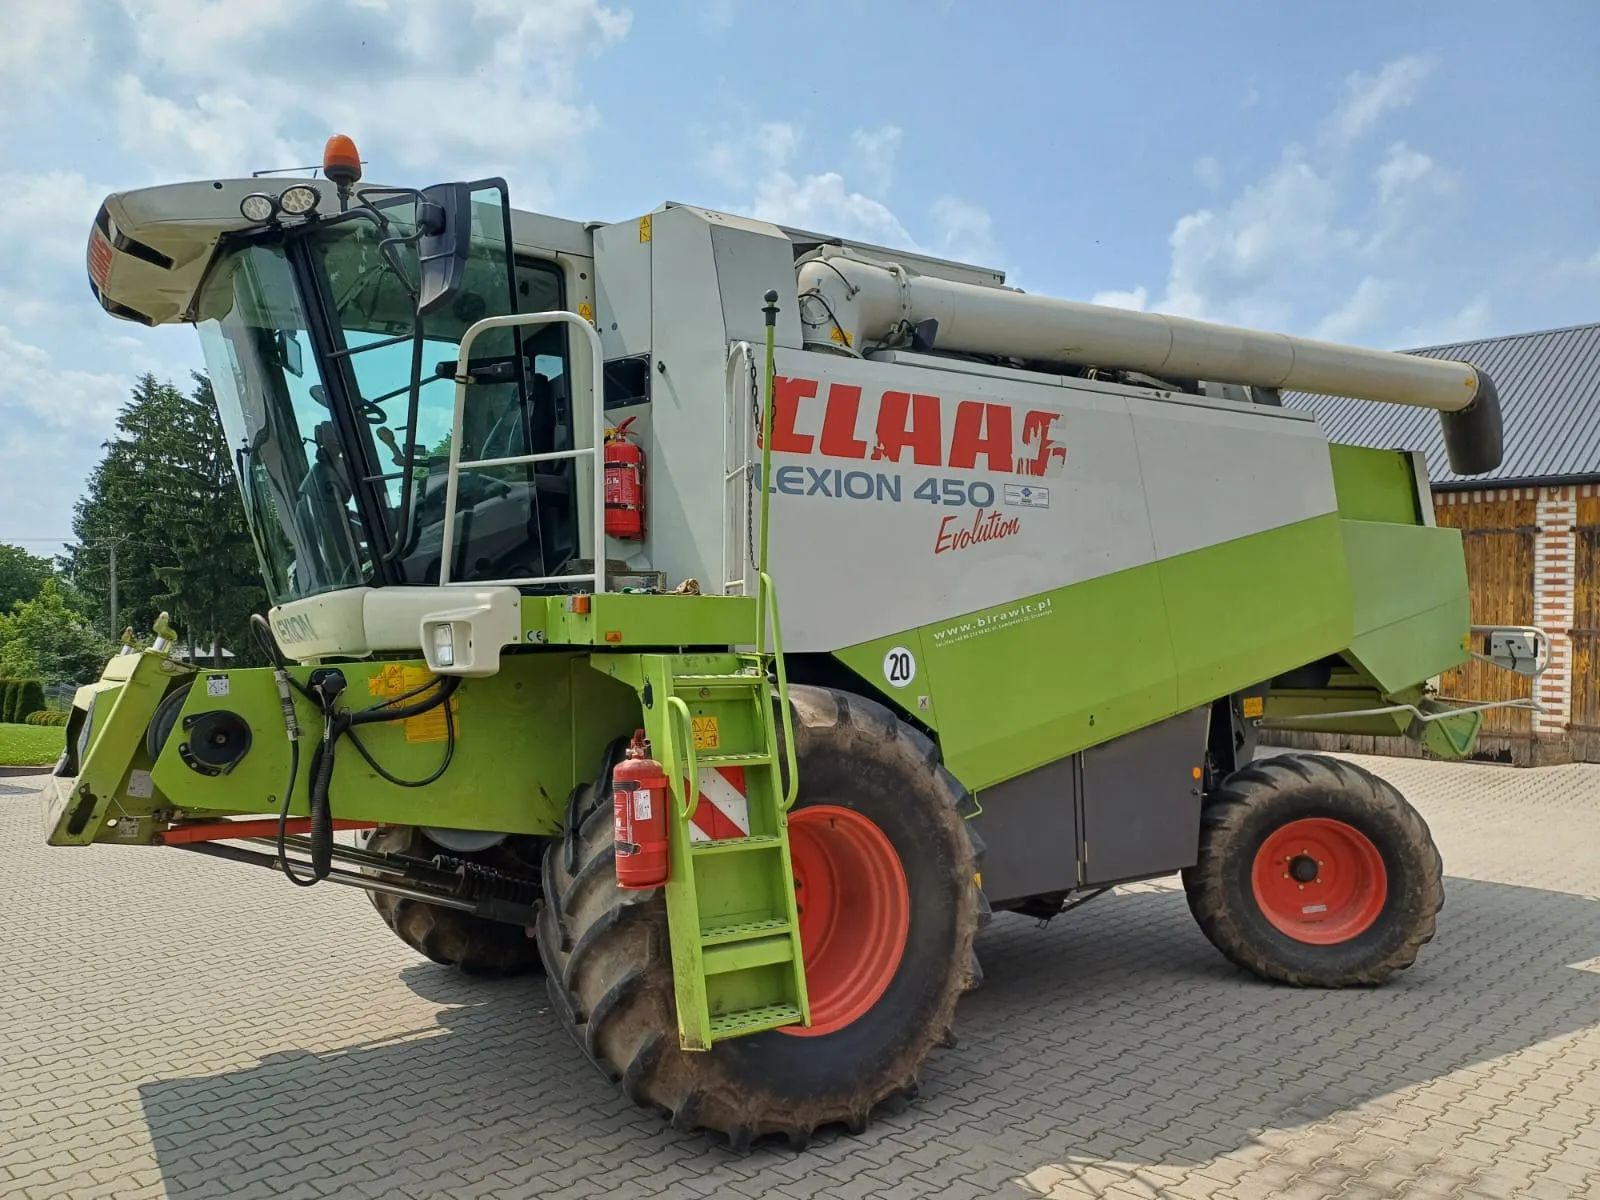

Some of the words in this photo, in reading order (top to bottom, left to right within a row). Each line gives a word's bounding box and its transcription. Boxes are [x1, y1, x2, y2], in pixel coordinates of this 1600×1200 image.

[754, 463, 901, 502] LEXION
[913, 477, 995, 508] 450
[934, 508, 1020, 554] Evolution
[933, 598, 1052, 640] www.birawit.pl
[889, 653, 910, 681] 20
